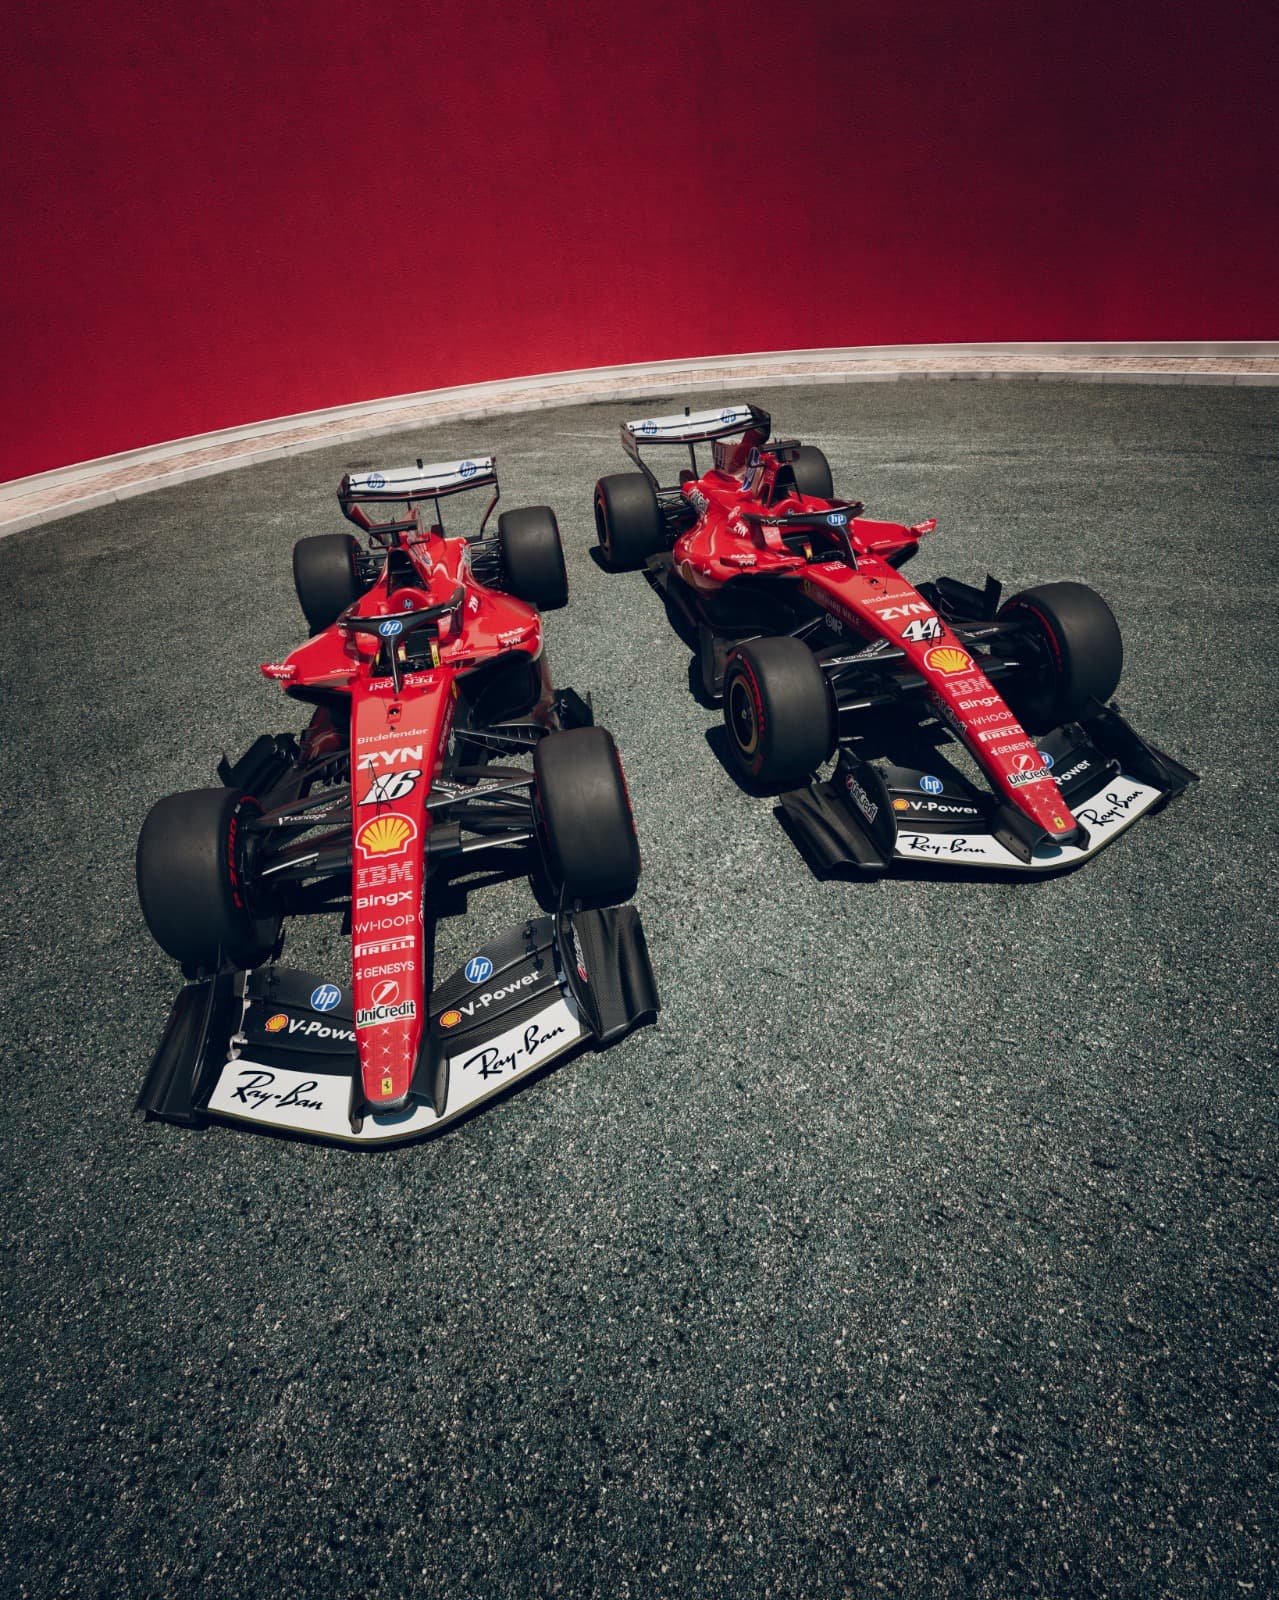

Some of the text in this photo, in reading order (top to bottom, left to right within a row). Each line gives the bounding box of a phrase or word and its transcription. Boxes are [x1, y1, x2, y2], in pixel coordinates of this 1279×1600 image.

[875, 602, 932, 621] ZYN
[901, 616, 943, 642] 44
[945, 676, 993, 697] IBM
[968, 711, 1013, 726] WHOOP
[357, 728, 429, 745] Bitdefender
[978, 724, 1025, 743] PIRELLI
[356, 745, 423, 770] ZYN
[357, 769, 423, 806] 16
[910, 801, 978, 815] V-Power
[1076, 790, 1143, 827] Ray-Ban
[898, 834, 987, 855] Ray-Ban
[357, 861, 414, 889] IBM
[355, 914, 415, 934] WHOOP
[354, 935, 416, 958] PIRELLI
[364, 961, 415, 978] GENESYS
[313, 985, 338, 1011] hp
[459, 971, 539, 1016] V-Power
[356, 1001, 415, 1024] UniCredit
[288, 1019, 357, 1042] V-Powe
[463, 1025, 565, 1080] Ray-Ban
[230, 1070, 323, 1110] Ray-Ban
